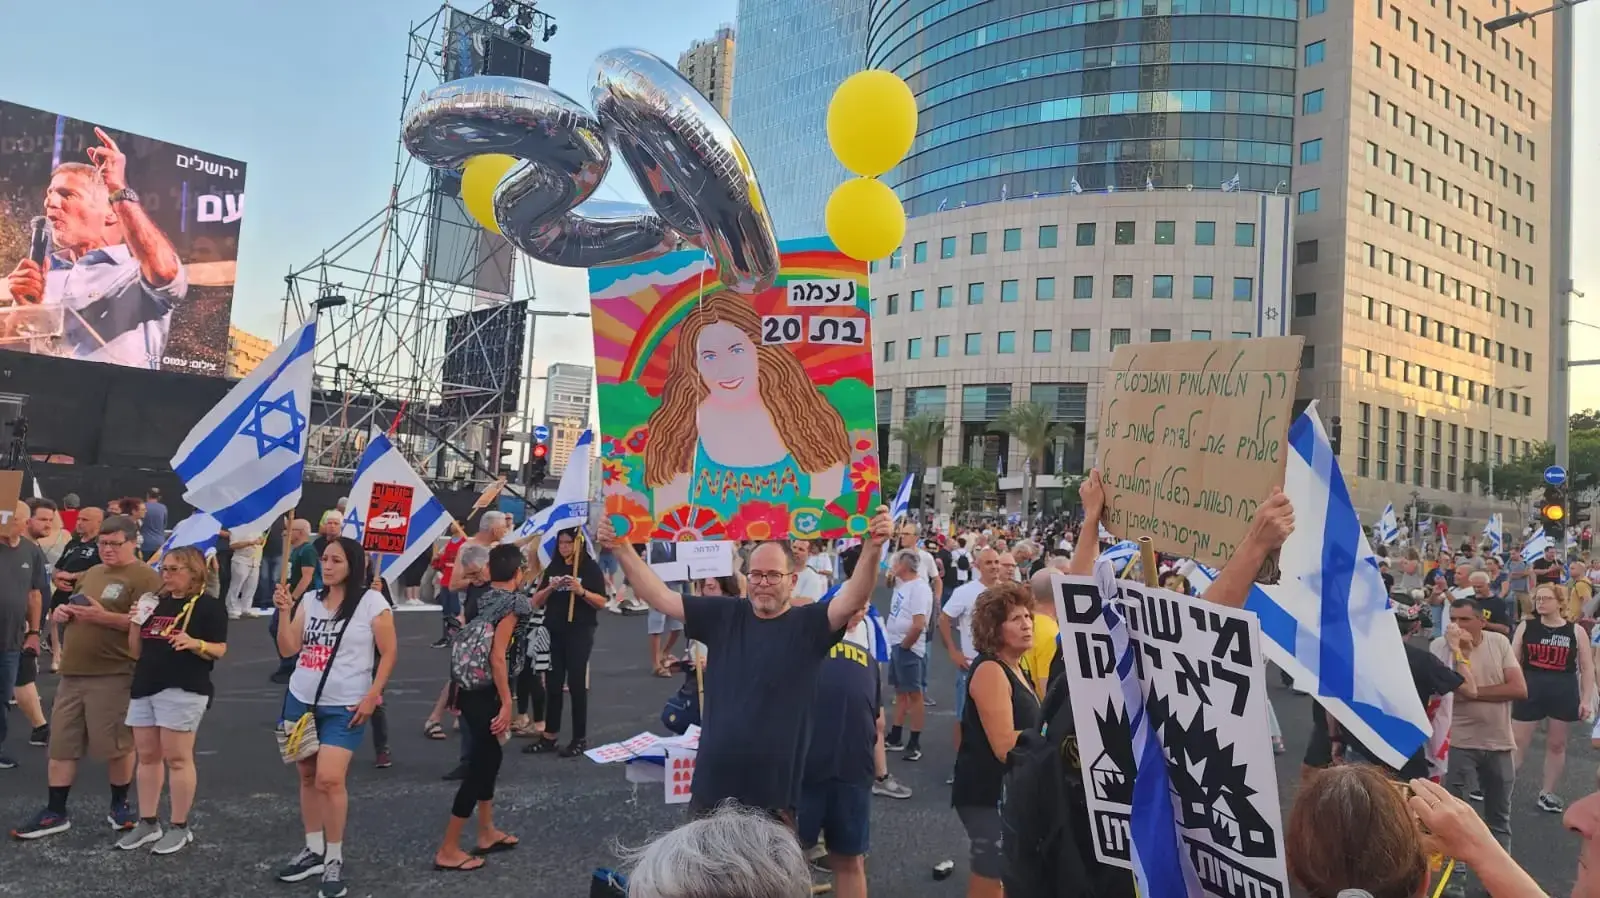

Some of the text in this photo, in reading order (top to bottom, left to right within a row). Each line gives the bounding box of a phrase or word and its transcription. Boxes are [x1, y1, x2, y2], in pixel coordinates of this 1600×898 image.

[176, 153, 239, 179] ירושלים
[197, 193, 243, 223] עם
[793, 282, 855, 302] נעמה
[764, 318, 863, 343] בת 20
[1178, 349, 1249, 397] מטומטמים
[1256, 372, 1286, 440] רק
[1105, 398, 1279, 463] שולחים את ילדיהם למות על
[695, 468, 799, 502] NAAMA
[1102, 448, 1112, 485] של
[1115, 456, 1151, 496] החולנית
[1152, 465, 1190, 518] השלטון
[1162, 521, 1211, 558] מקיסריה
[1189, 606, 1253, 667] מי
[1173, 652, 1250, 717] לא
